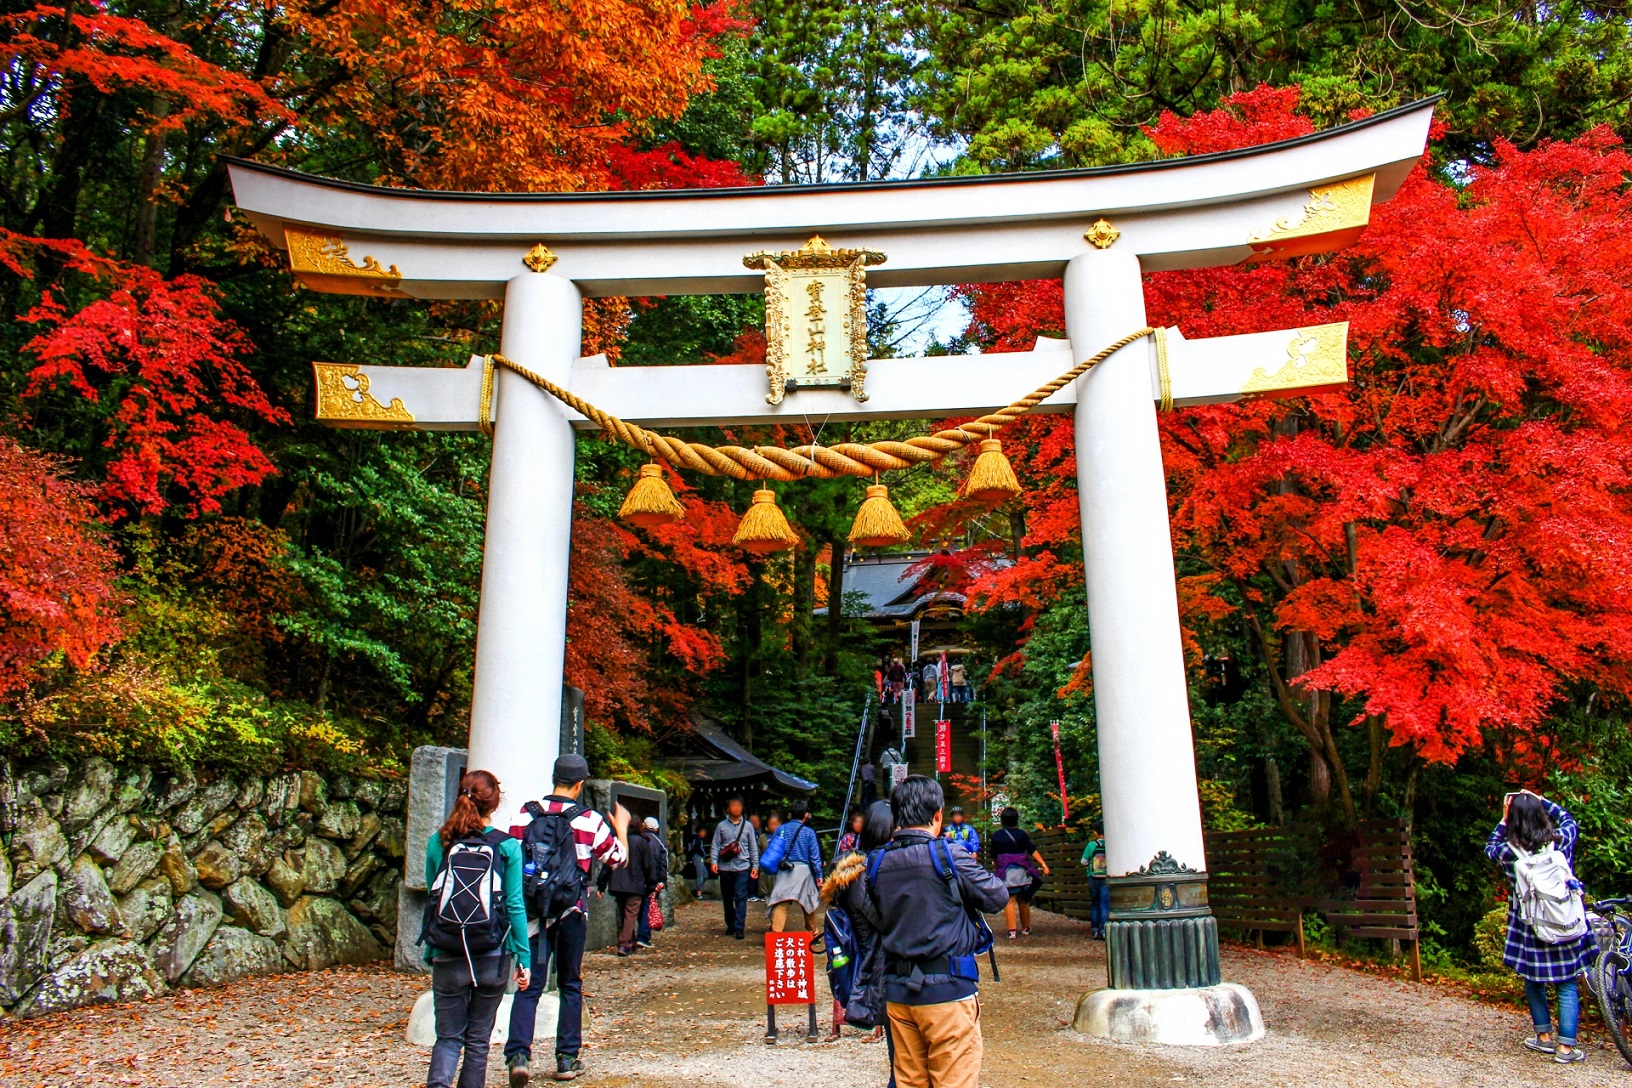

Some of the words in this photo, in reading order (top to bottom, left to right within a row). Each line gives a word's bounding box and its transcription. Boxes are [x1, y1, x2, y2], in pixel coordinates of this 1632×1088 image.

[774, 937, 785, 999] ご遠慮下さい
[785, 937, 796, 989] 犬の散歩は
